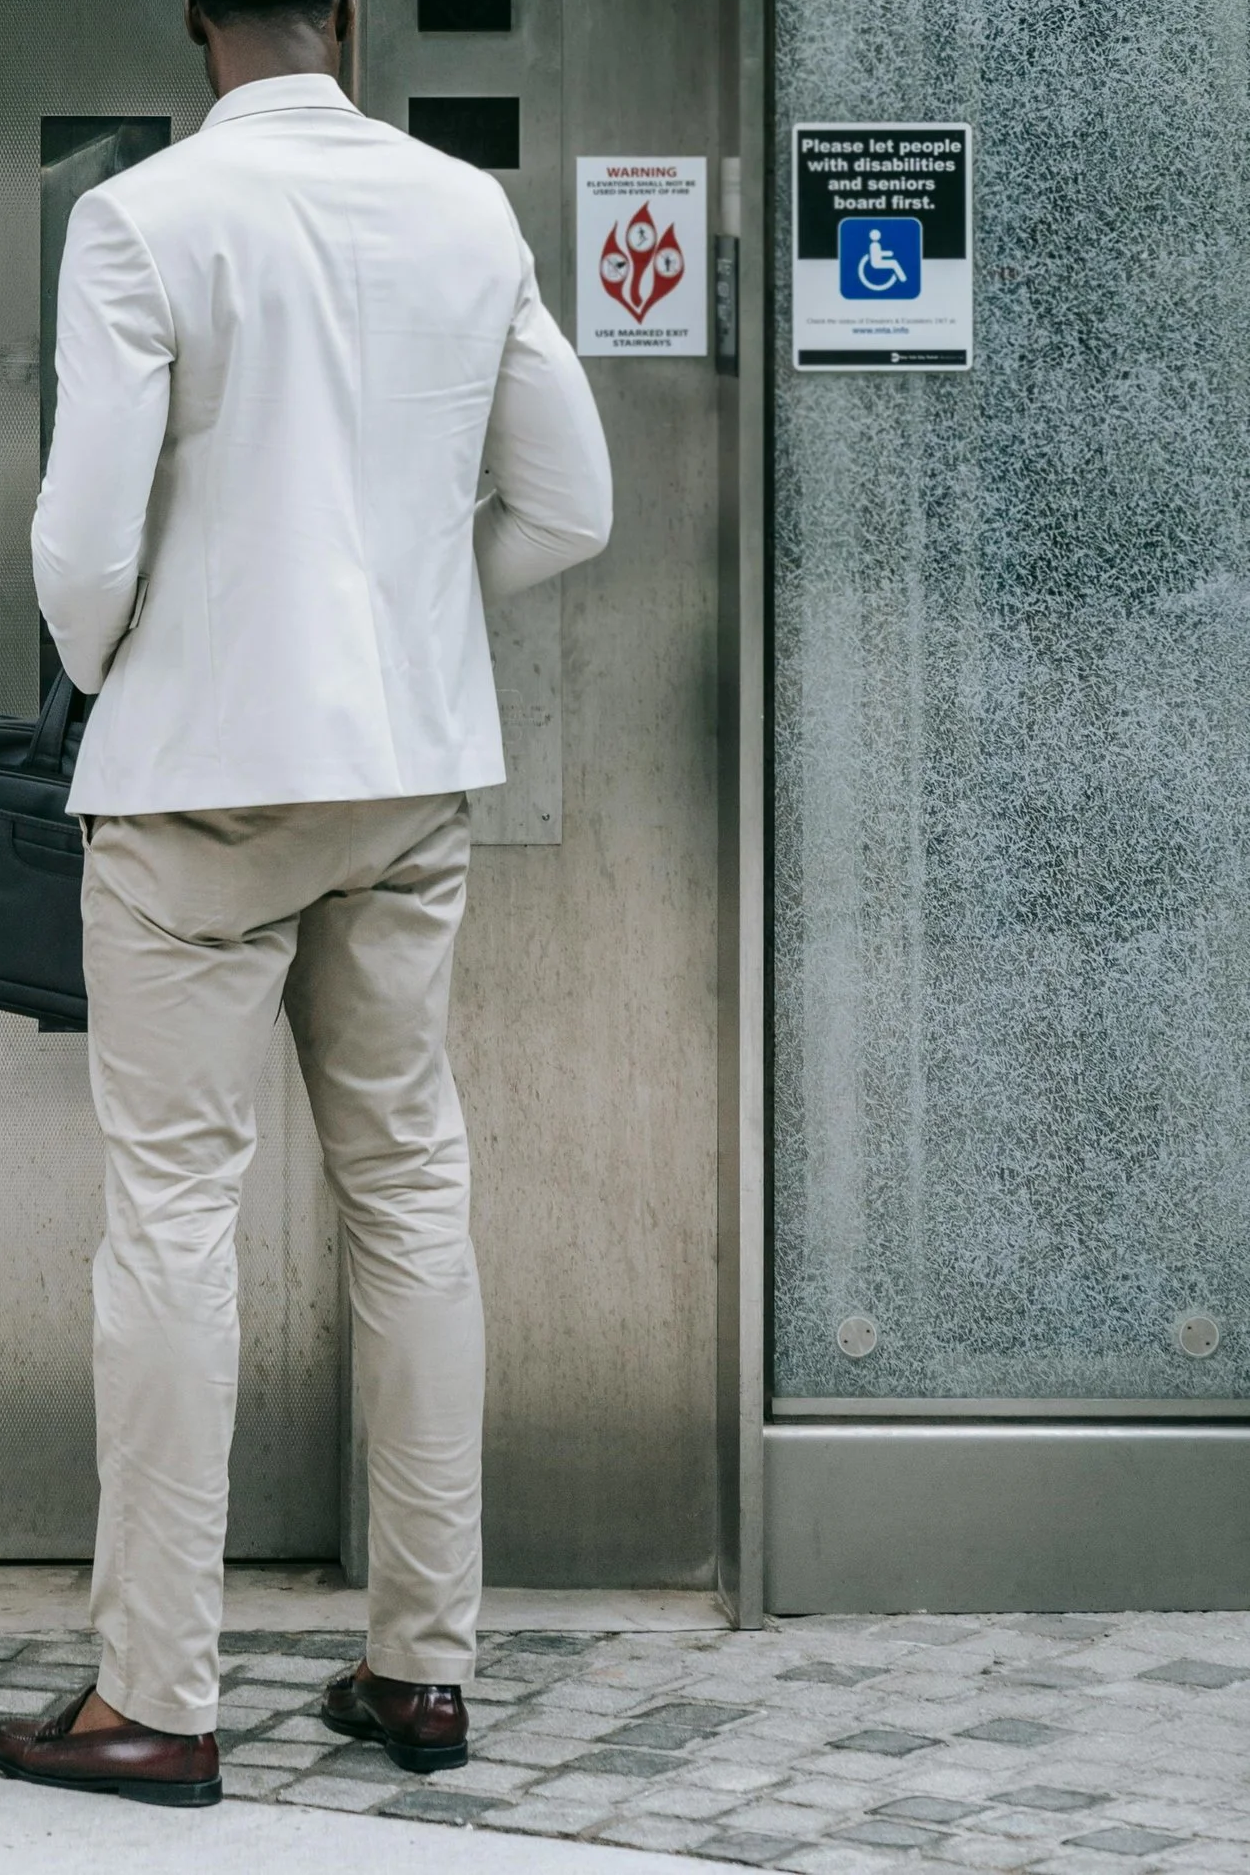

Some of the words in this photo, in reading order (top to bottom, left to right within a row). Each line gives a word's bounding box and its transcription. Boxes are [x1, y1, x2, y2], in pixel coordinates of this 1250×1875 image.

[801, 139, 864, 154] Please
[869, 139, 894, 154] let
[899, 139, 962, 156] people
[807, 158, 849, 172] with
[853, 158, 956, 172] disabilities
[606, 166, 678, 178] WARNING
[586, 180, 635, 188] ELEVATORS
[636, 180, 663, 188] SHALL
[827, 177, 863, 191] and
[867, 177, 936, 191] seniors
[592, 188, 617, 196] USED
[617, 188, 628, 196] IN
[628, 188, 657, 196] EVENT
[658, 188, 670, 196] OF
[671, 188, 690, 196] FIRE
[833, 195, 887, 210] board
[891, 195, 935, 210] first.
[594, 329, 615, 338] USE
[617, 329, 664, 338] MARKED
[665, 329, 689, 338] EXIT
[851, 326, 910, 335] www.mta.info
[612, 338, 672, 347] STAIRWAYS
